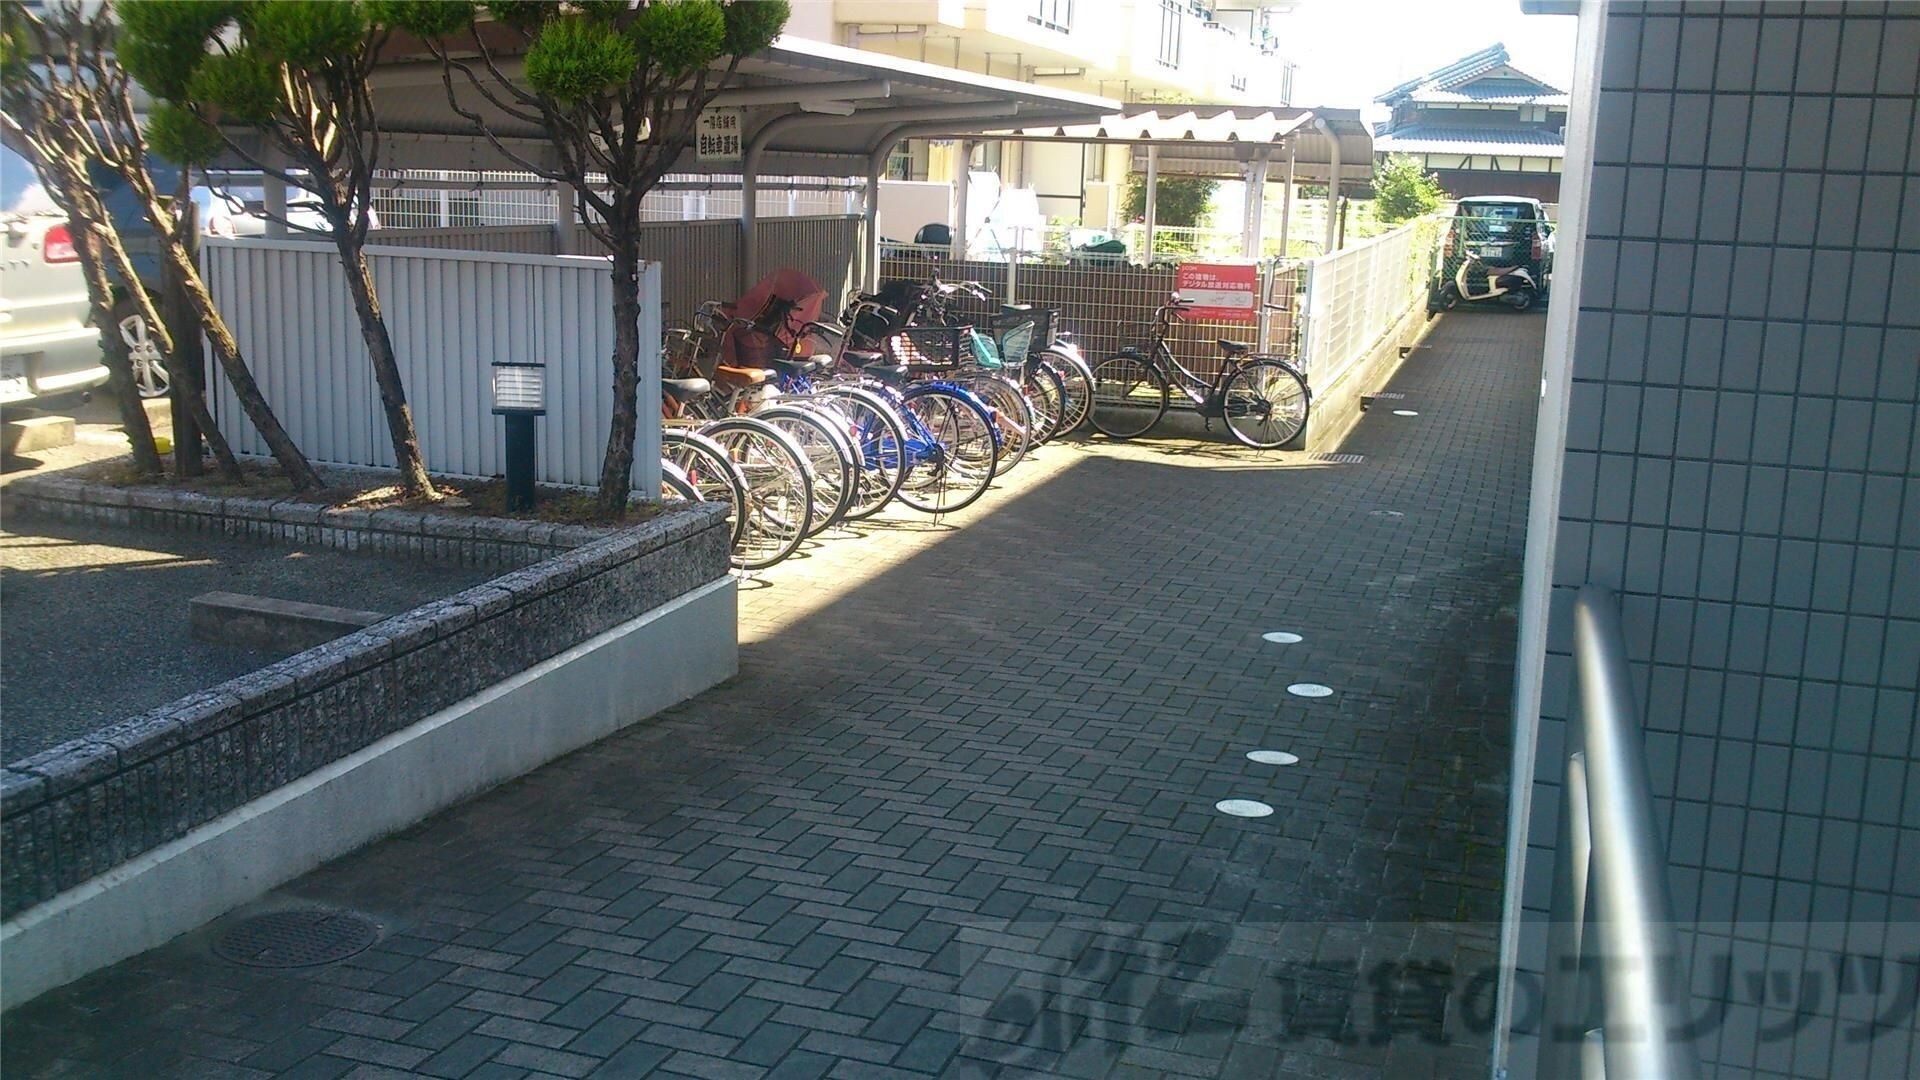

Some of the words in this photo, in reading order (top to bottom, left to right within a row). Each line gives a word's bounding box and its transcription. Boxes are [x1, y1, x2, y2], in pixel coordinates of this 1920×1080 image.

[700, 133, 739, 156] 自転車置場
